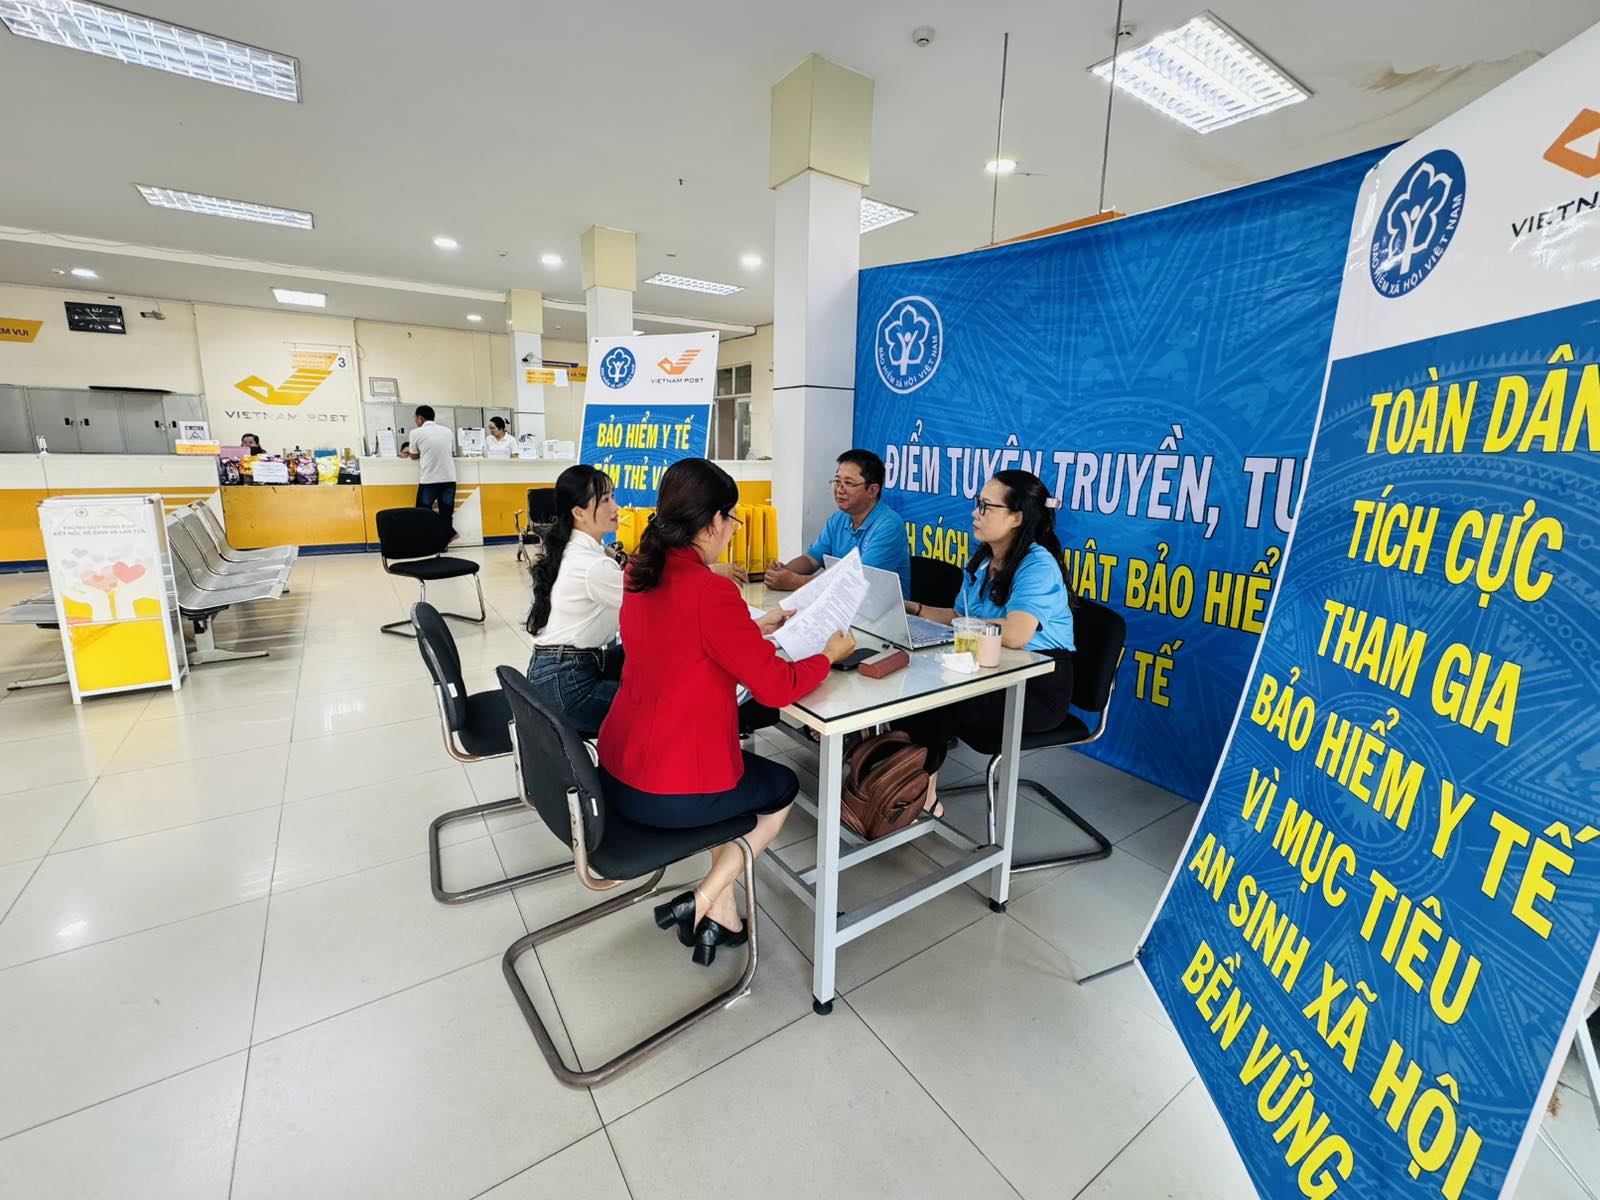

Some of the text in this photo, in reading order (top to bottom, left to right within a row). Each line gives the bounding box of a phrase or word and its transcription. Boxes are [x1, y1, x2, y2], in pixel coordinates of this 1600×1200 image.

[1446, 193, 1463, 230] NAM
[1511, 190, 1600, 238] VIETN
[13, 328, 29, 336] VUI
[338, 357, 346, 368] 3
[225, 410, 349, 422] VIETNAM POST
[597, 411, 695, 449] BẢO HIỂM Y TẾ
[1366, 343, 1600, 454] TOÀN DÂN
[624, 456, 648, 490] THẺ
[884, 419, 940, 495] ĐIỂM
[1052, 424, 1220, 539] TRUYỀN,
[921, 516, 969, 568] SÁCH
[1125, 542, 1195, 619] BẢO
[1203, 546, 1281, 634] HIỂ
[1347, 485, 1564, 608] TÍCH CỰC
[1134, 640, 1184, 707] TẾ
[1317, 599, 1522, 747] THAM GIA
[1250, 666, 1600, 940] BẢO HIỂM Y TẾ
[1241, 767, 1482, 1025] VÌ MỤC TIÊU
[1180, 940, 1355, 1200] BỀN VỮNG
[1188, 833, 1483, 1200] AN SINH XÃ HỘI
